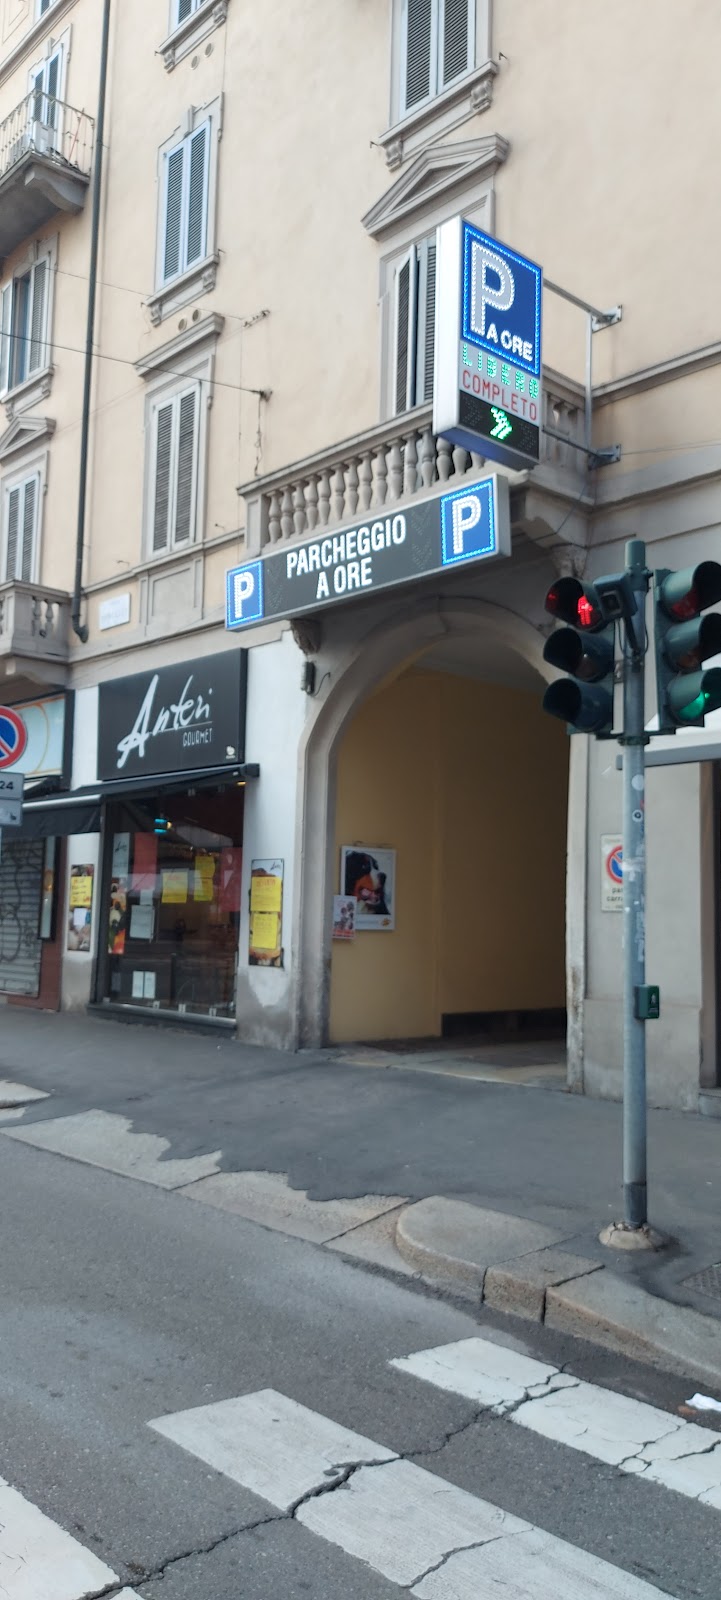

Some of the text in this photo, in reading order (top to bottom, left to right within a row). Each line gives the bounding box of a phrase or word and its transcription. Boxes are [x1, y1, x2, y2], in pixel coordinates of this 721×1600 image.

[470, 240, 515, 336] P
[486, 323, 533, 362] A ORE
[462, 343, 539, 399] LIBERO
[462, 370, 537, 421] COMPLETO
[286, 514, 407, 579] PARCHEGGIO
[452, 494, 481, 554] P
[233, 572, 254, 618] P
[316, 557, 373, 599] A ORE
[182, 727, 213, 748] GOURMET
